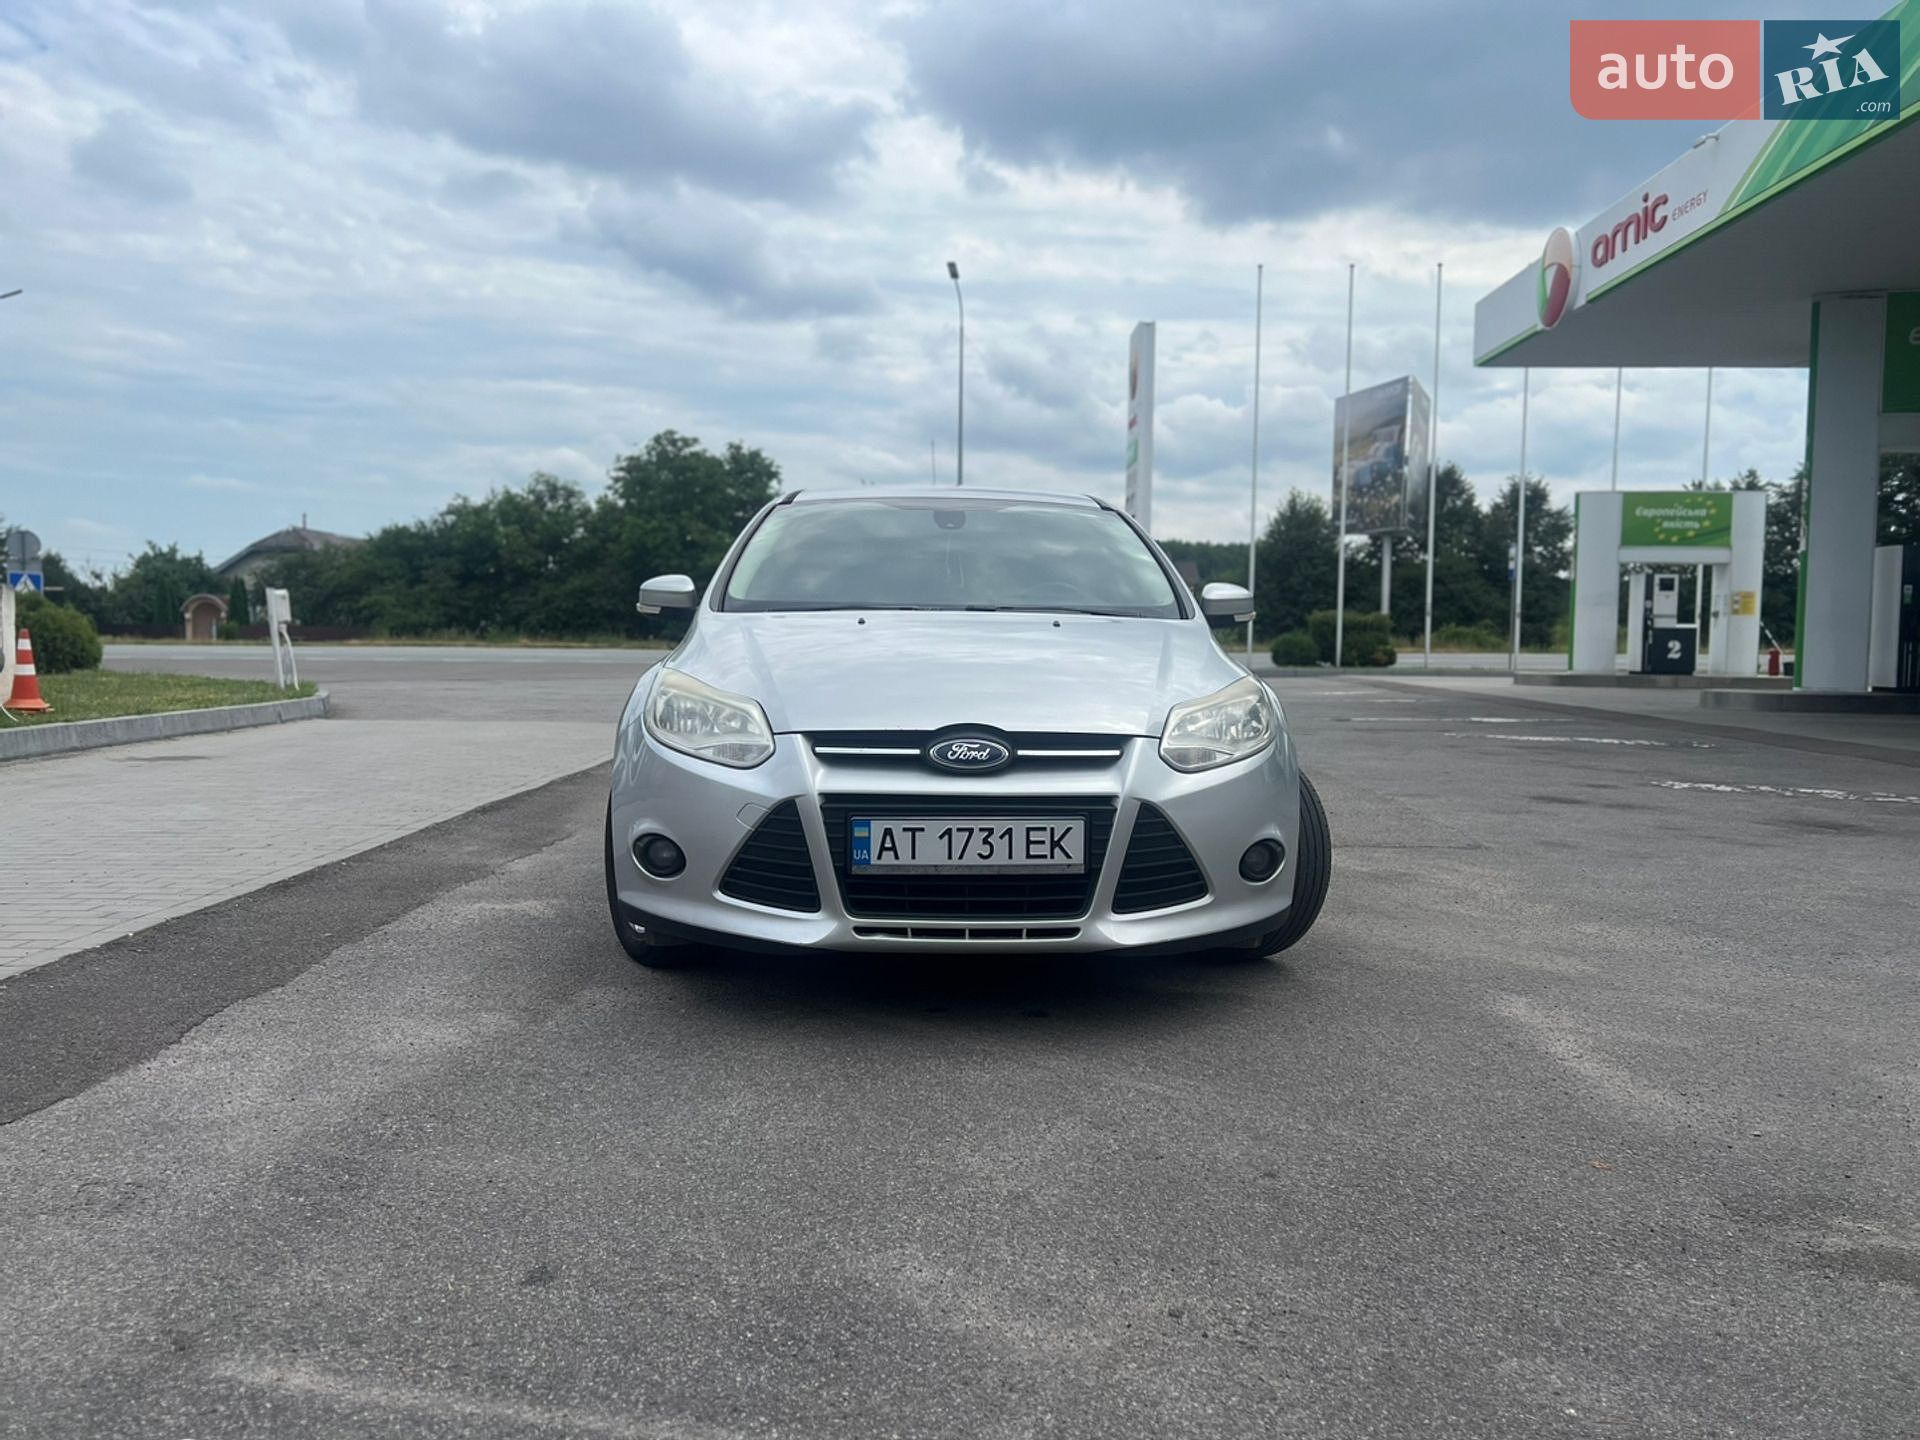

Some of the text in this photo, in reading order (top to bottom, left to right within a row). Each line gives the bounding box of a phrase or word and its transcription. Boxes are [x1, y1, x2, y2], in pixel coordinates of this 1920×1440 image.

[1591, 190, 1709, 268] amic ENERGY
[1666, 639, 1682, 659] 2
[947, 742, 991, 761] Ford
[876, 826, 1074, 861] AT 1731 EK
[853, 849, 869, 861] UA
